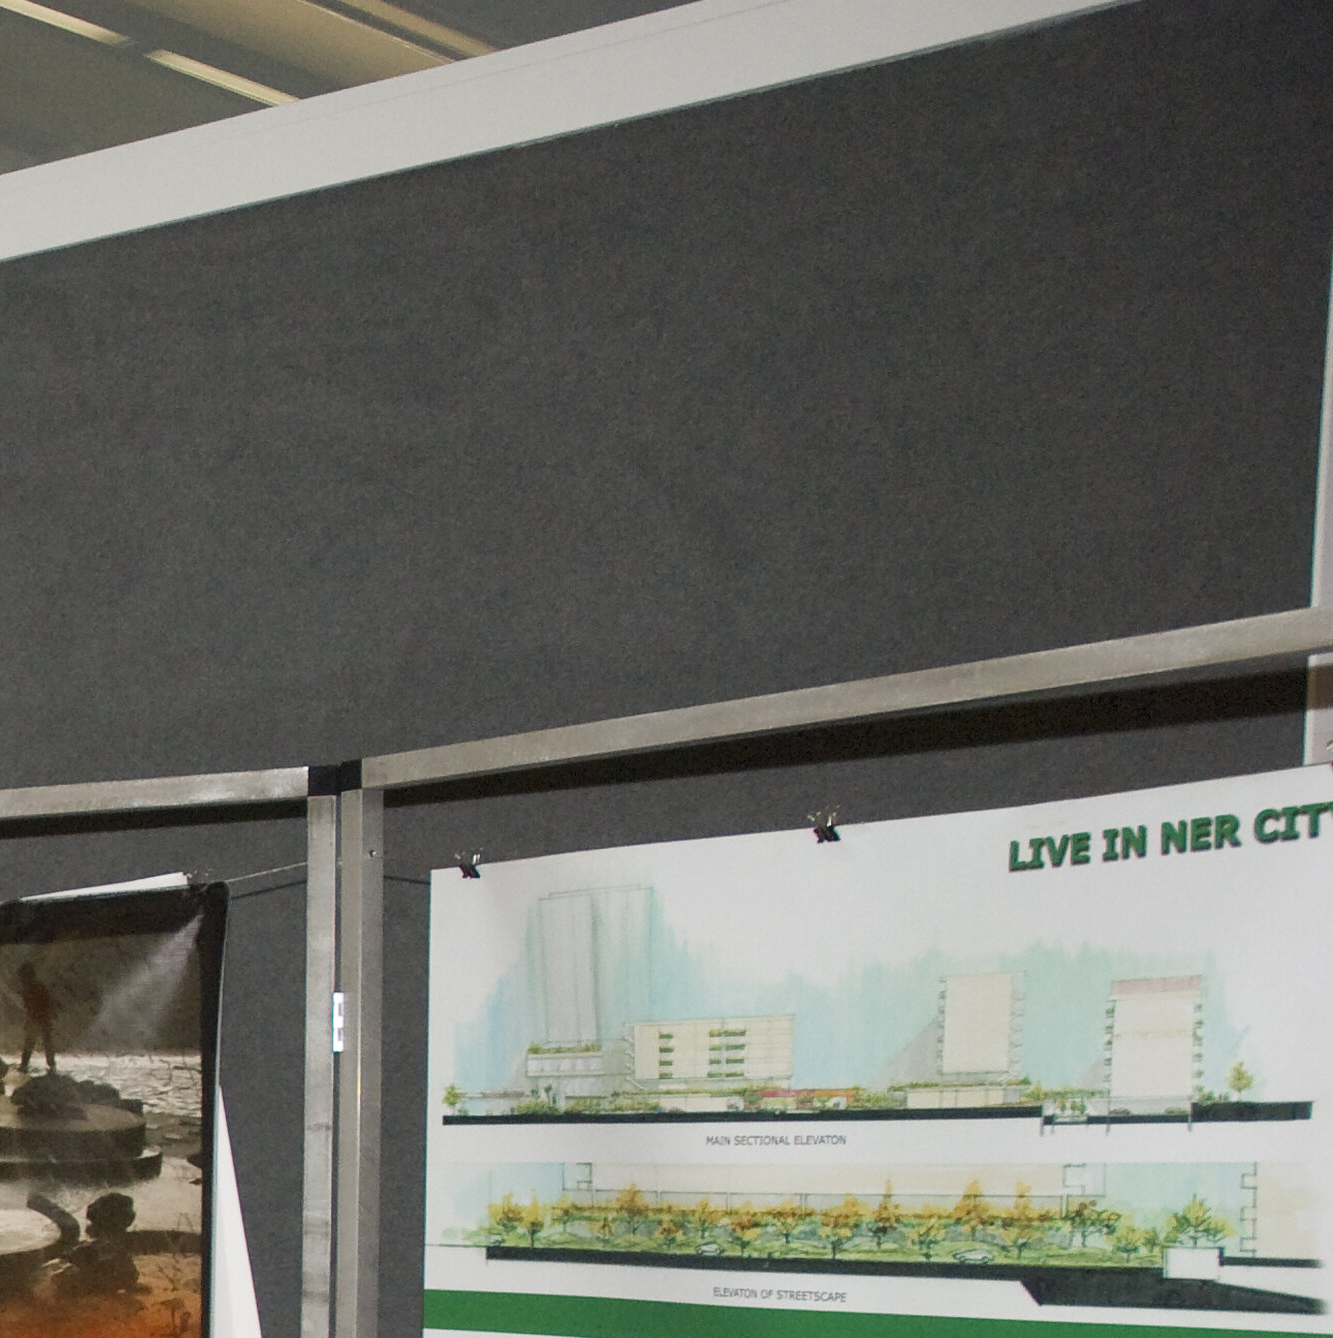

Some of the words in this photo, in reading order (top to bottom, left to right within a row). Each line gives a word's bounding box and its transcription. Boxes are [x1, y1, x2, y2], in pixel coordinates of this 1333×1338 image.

[1009, 832, 1090, 872] LIVE
[1103, 825, 1147, 861] IN
[1161, 814, 1241, 855] NER
[1254, 802, 1333, 844] CIT
[706, 1136, 730, 1145] MAIN
[735, 1136, 790, 1145] SECTIONAL
[777, 1290, 846, 1302] STREETSCAPE
